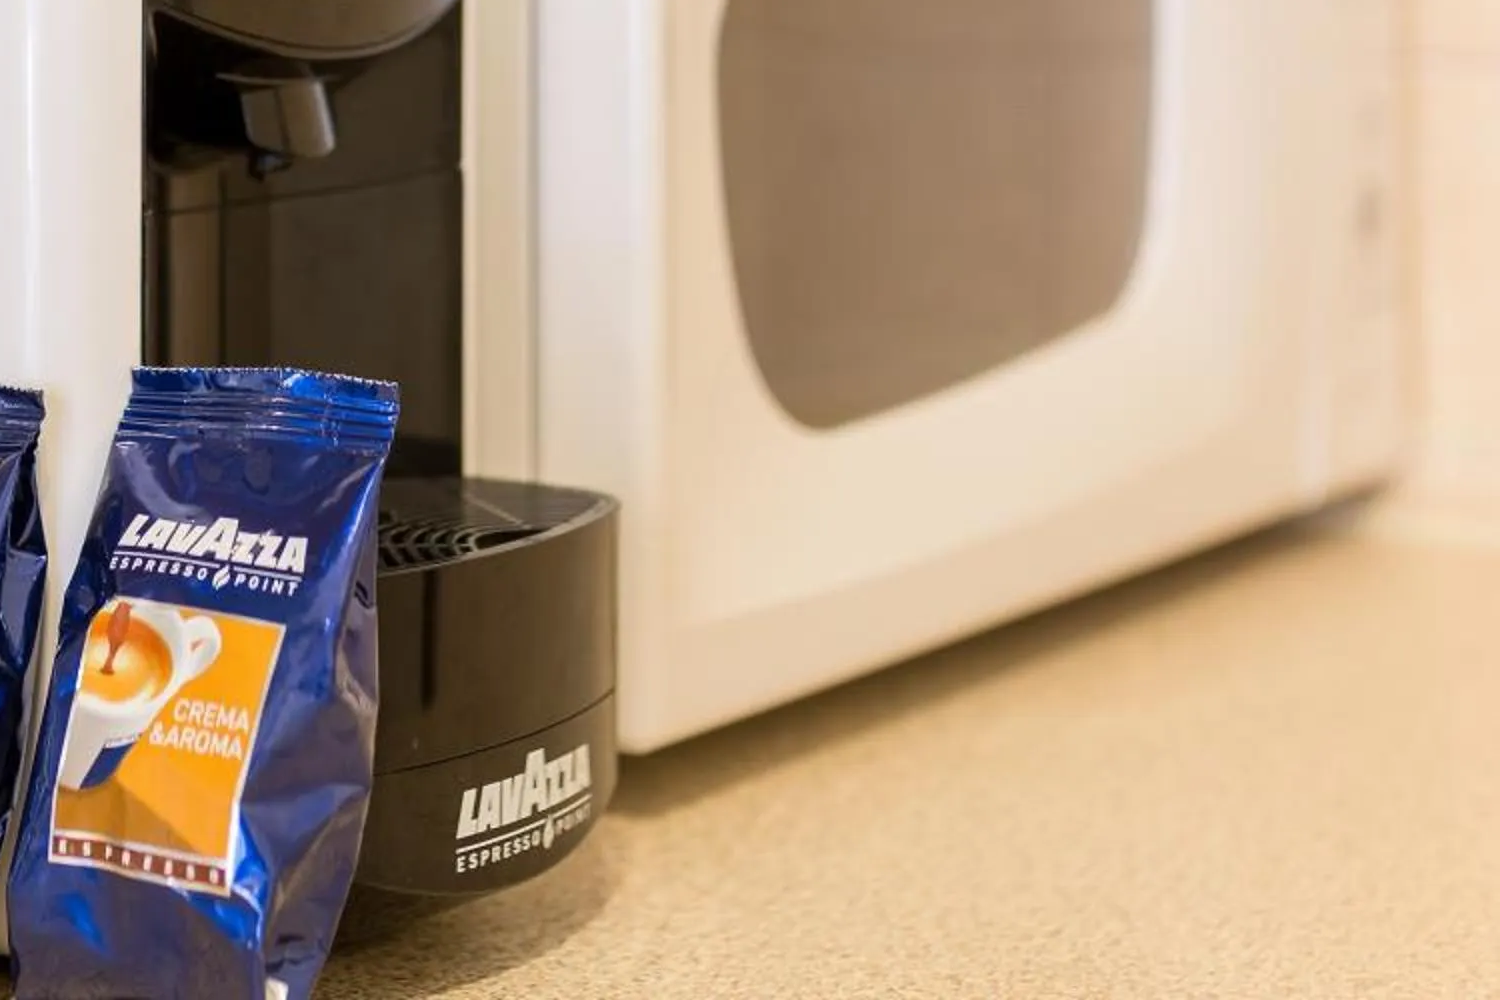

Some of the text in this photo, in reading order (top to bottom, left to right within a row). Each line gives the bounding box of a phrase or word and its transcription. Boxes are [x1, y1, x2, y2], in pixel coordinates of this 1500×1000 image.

[117, 512, 309, 573] LAVAZZA
[109, 556, 299, 597] ESPRESSO POINT
[174, 697, 249, 735] CREMA
[148, 720, 242, 760] &AROMA
[456, 829, 541, 874] ESPRESSO
